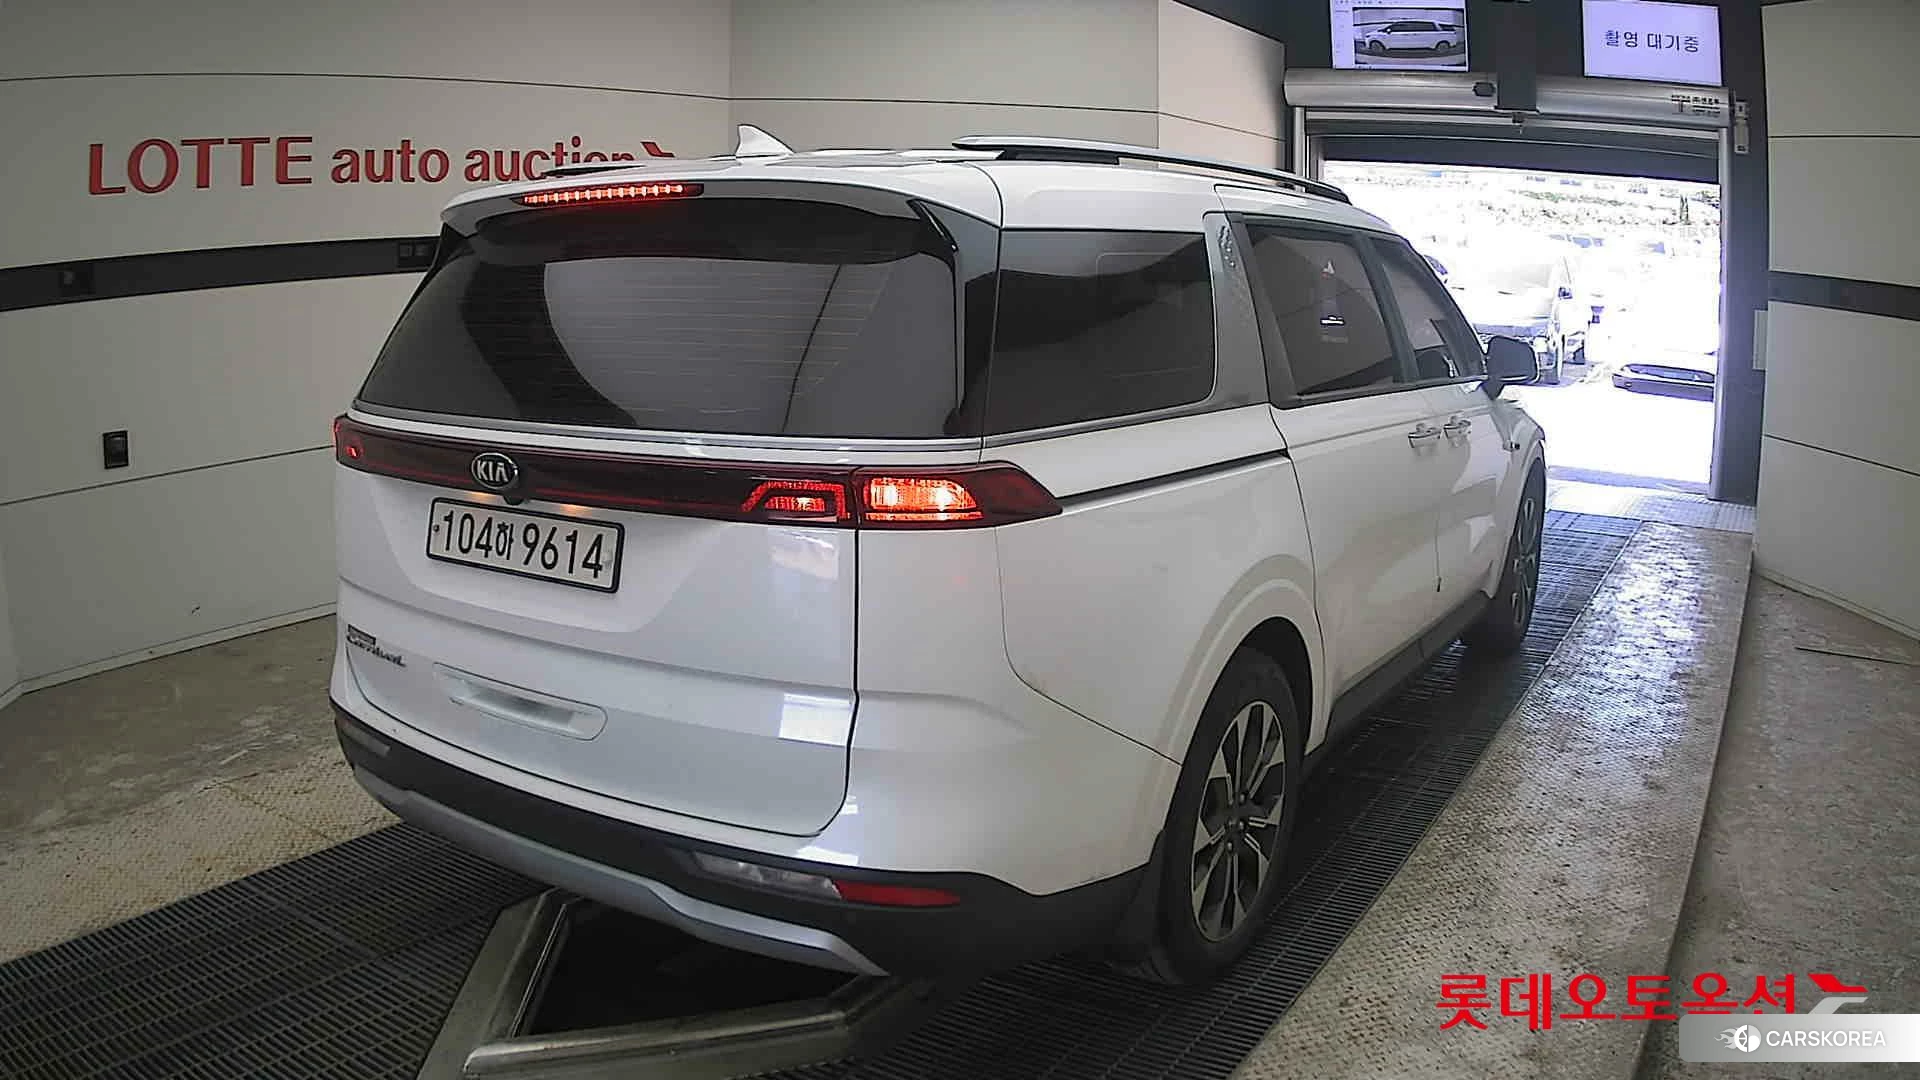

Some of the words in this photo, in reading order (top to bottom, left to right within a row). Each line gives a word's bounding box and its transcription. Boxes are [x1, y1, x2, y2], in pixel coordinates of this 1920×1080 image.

[1605, 29, 1638, 48] 촬영
[1647, 33, 1699, 53] 대기중
[89, 136, 313, 195] LOTTE
[331, 140, 450, 184] auto
[464, 135, 635, 183] aucti
[475, 461, 509, 482] KIA
[522, 523, 603, 579] 9614
